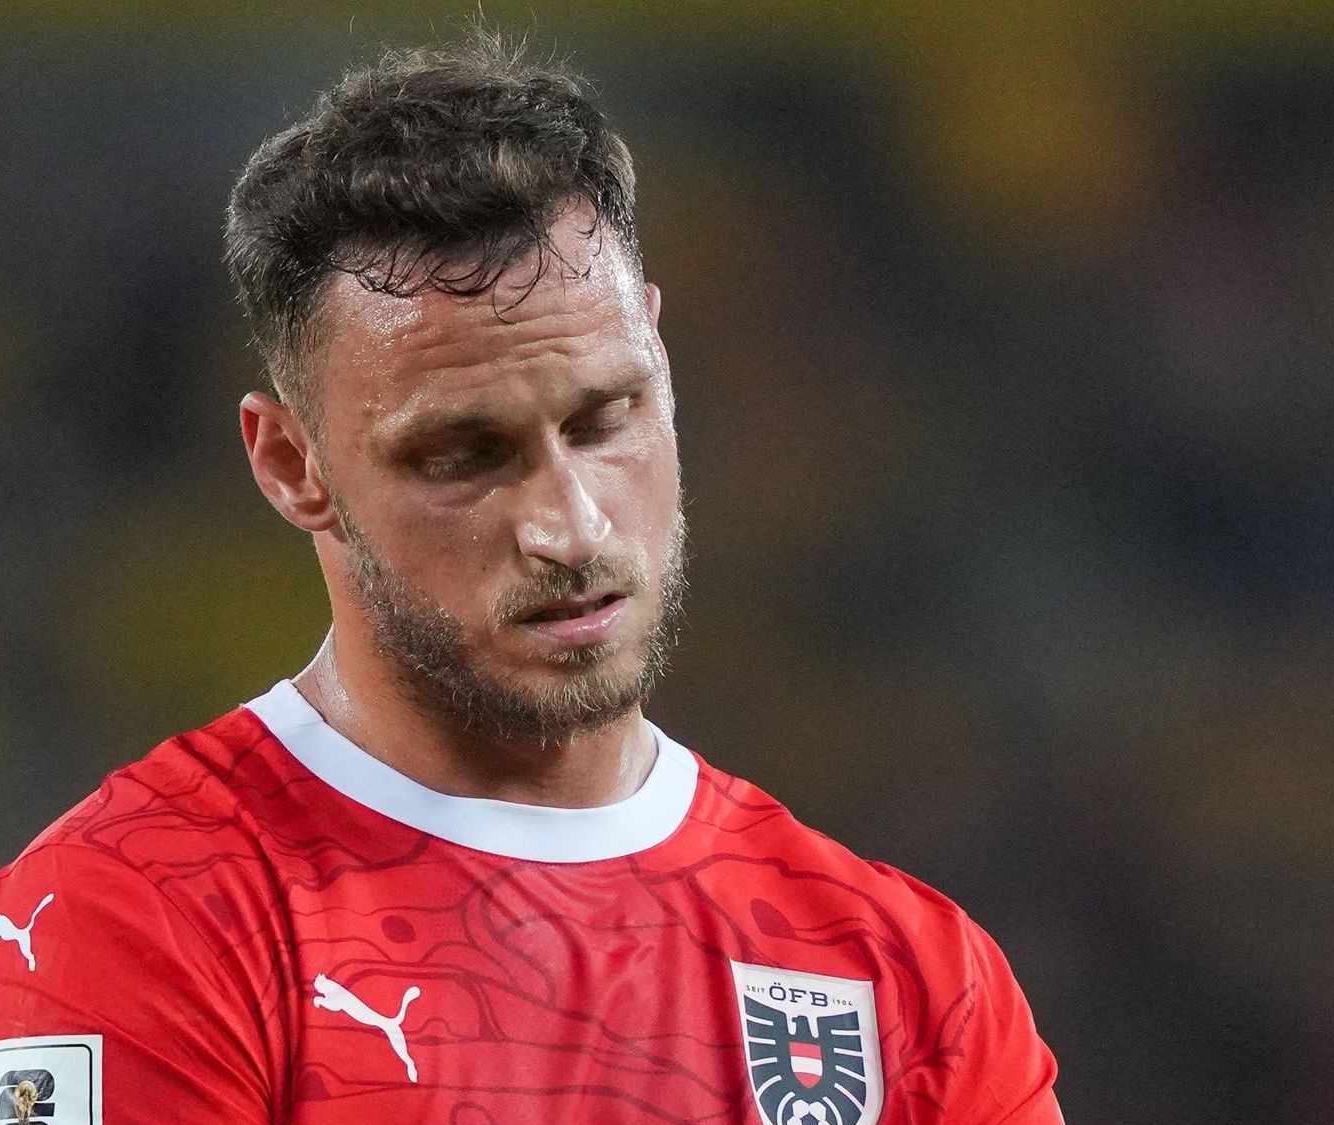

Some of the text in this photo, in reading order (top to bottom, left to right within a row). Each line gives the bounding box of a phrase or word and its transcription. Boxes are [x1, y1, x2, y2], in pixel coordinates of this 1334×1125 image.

[746, 982, 853, 1007] SEIT ÖFB 1904
